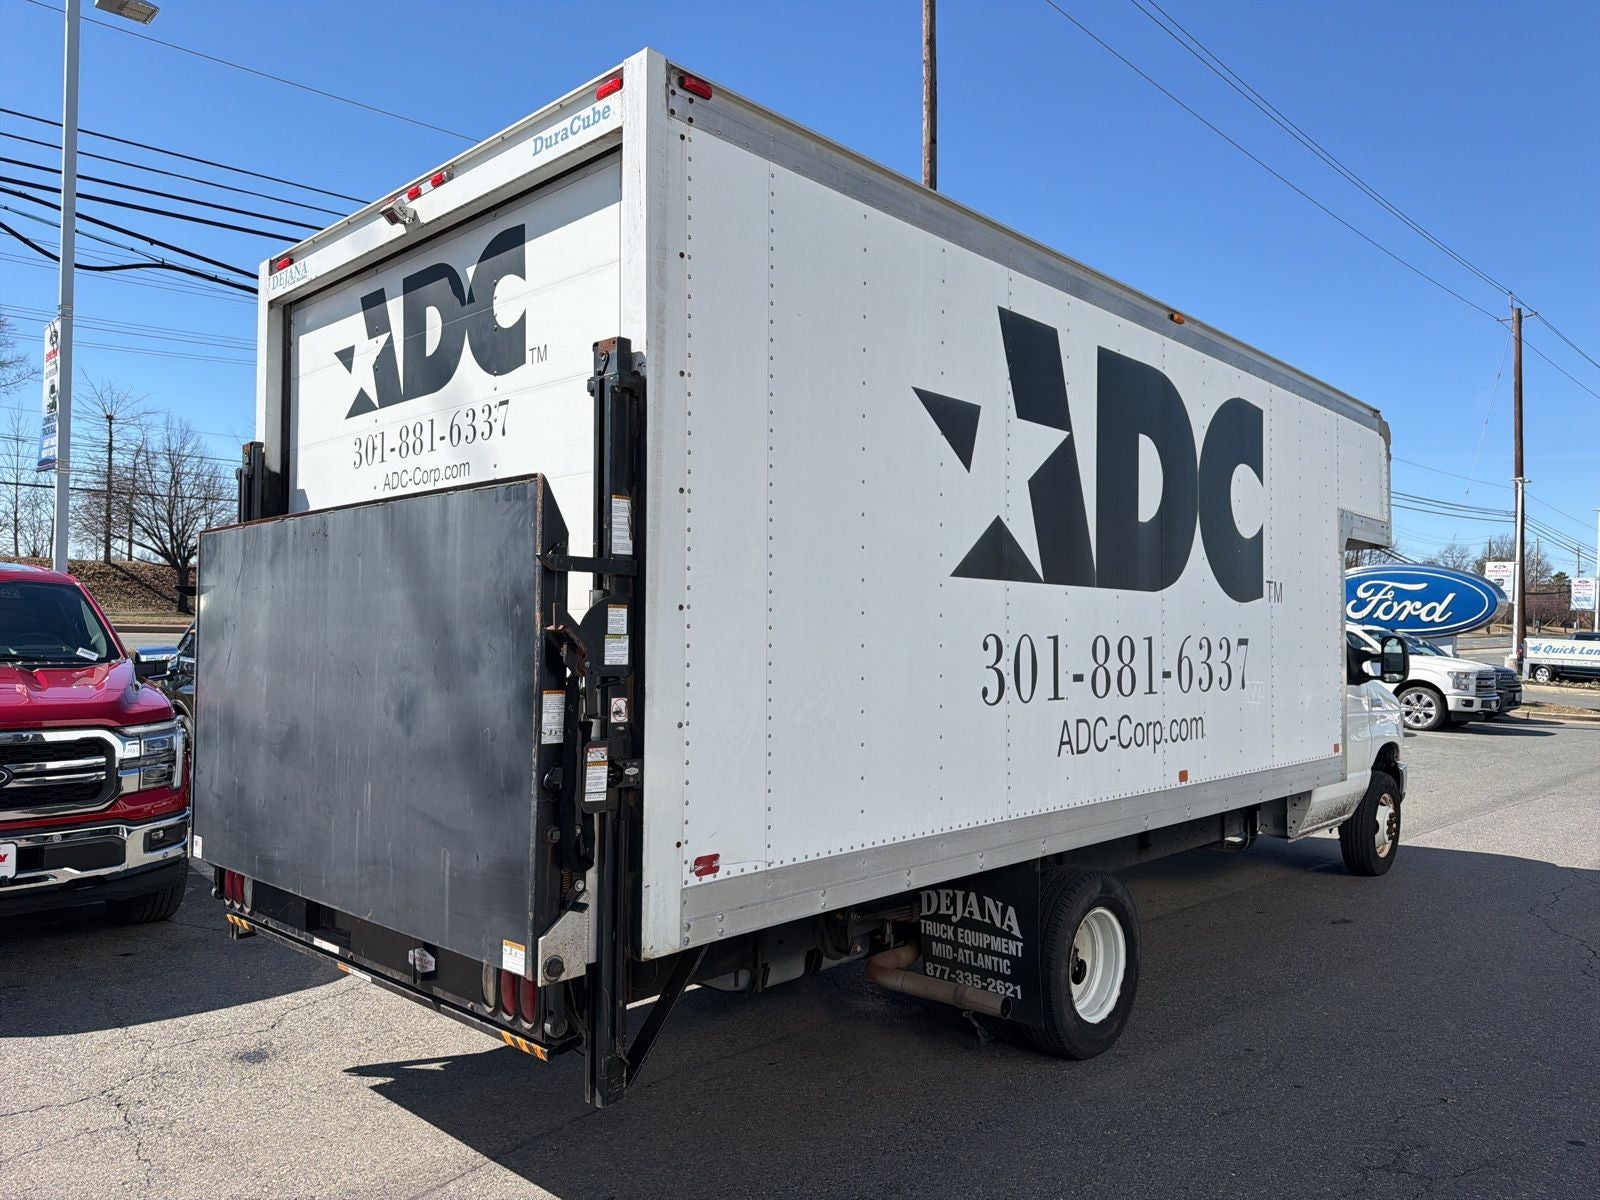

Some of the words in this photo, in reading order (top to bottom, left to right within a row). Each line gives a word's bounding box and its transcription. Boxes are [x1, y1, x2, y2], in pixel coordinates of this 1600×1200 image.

[532, 105, 611, 156] DuraCube
[271, 260, 307, 290] DEJANA
[334, 223, 526, 419] ADC
[528, 344, 548, 365] TM
[353, 399, 510, 469] 301-881-6337
[911, 305, 1264, 603] ADC
[1266, 580, 1283, 604] TM
[382, 459, 470, 491] ADC-Corp.com
[1346, 580, 1456, 623] Ford
[981, 633, 1249, 706] 301-881-6337
[1543, 645, 1577, 655] Quick
[1057, 714, 1204, 757] ADC-Corp.com
[919, 889, 1023, 939] DEJANA
[920, 919, 954, 941] TRUCK
[957, 930, 1023, 957] EQUIPMENT
[932, 941, 1011, 975] MID-ATLANTIC
[925, 961, 1022, 1000] 877-335-2621
